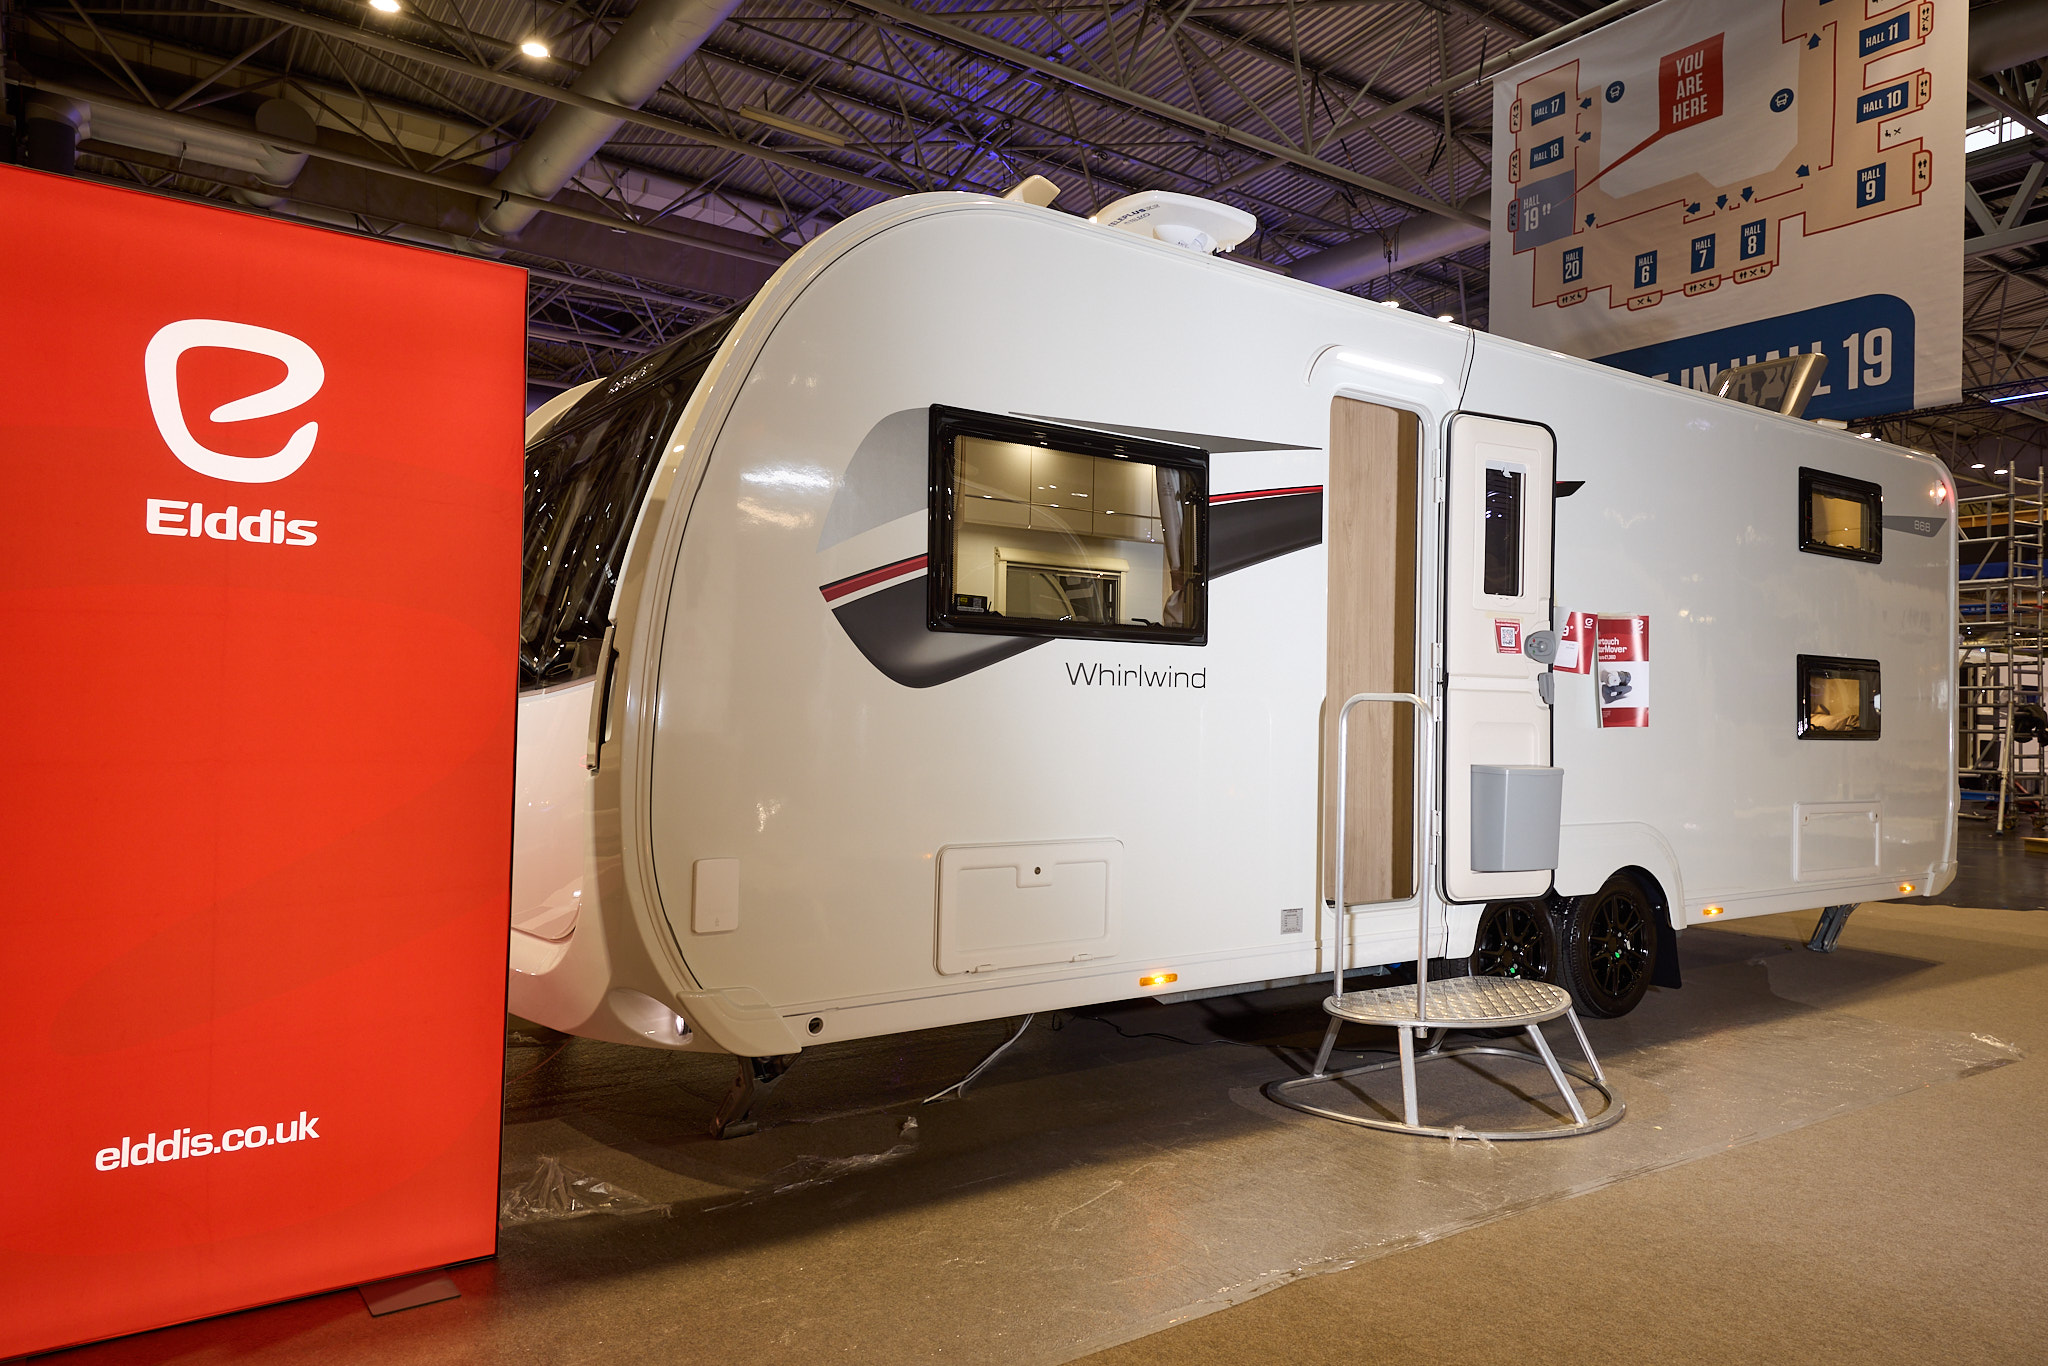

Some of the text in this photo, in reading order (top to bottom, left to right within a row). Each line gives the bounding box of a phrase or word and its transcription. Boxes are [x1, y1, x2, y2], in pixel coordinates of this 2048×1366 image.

[1865, 22, 1899, 48] HALL 11
[1676, 50, 1704, 77] YOU
[1676, 72, 1703, 100] ARE
[1534, 98, 1560, 118] HALL 17
[1672, 93, 1708, 124] HERE
[1863, 89, 1902, 114] HALL 10
[1533, 142, 1559, 162] HALL 18
[1861, 167, 1881, 182] HALL
[1865, 180, 1876, 201] 9
[1523, 194, 1540, 210] HALL
[1523, 206, 1539, 232] 19
[1744, 224, 1761, 237] HALL
[1695, 239, 1711, 251] HALL
[1747, 235, 1757, 255] 8
[1565, 251, 1579, 263] HALL
[1638, 255, 1653, 267] HALL
[1699, 249, 1707, 268] 7
[1565, 260, 1579, 280] 20
[1641, 265, 1650, 284] 6
[1843, 327, 1892, 390] 19
[146, 498, 318, 547] Elddis
[1065, 662, 1206, 689] Whirlwind
[95, 1110, 320, 1172] elddis.co.uk
